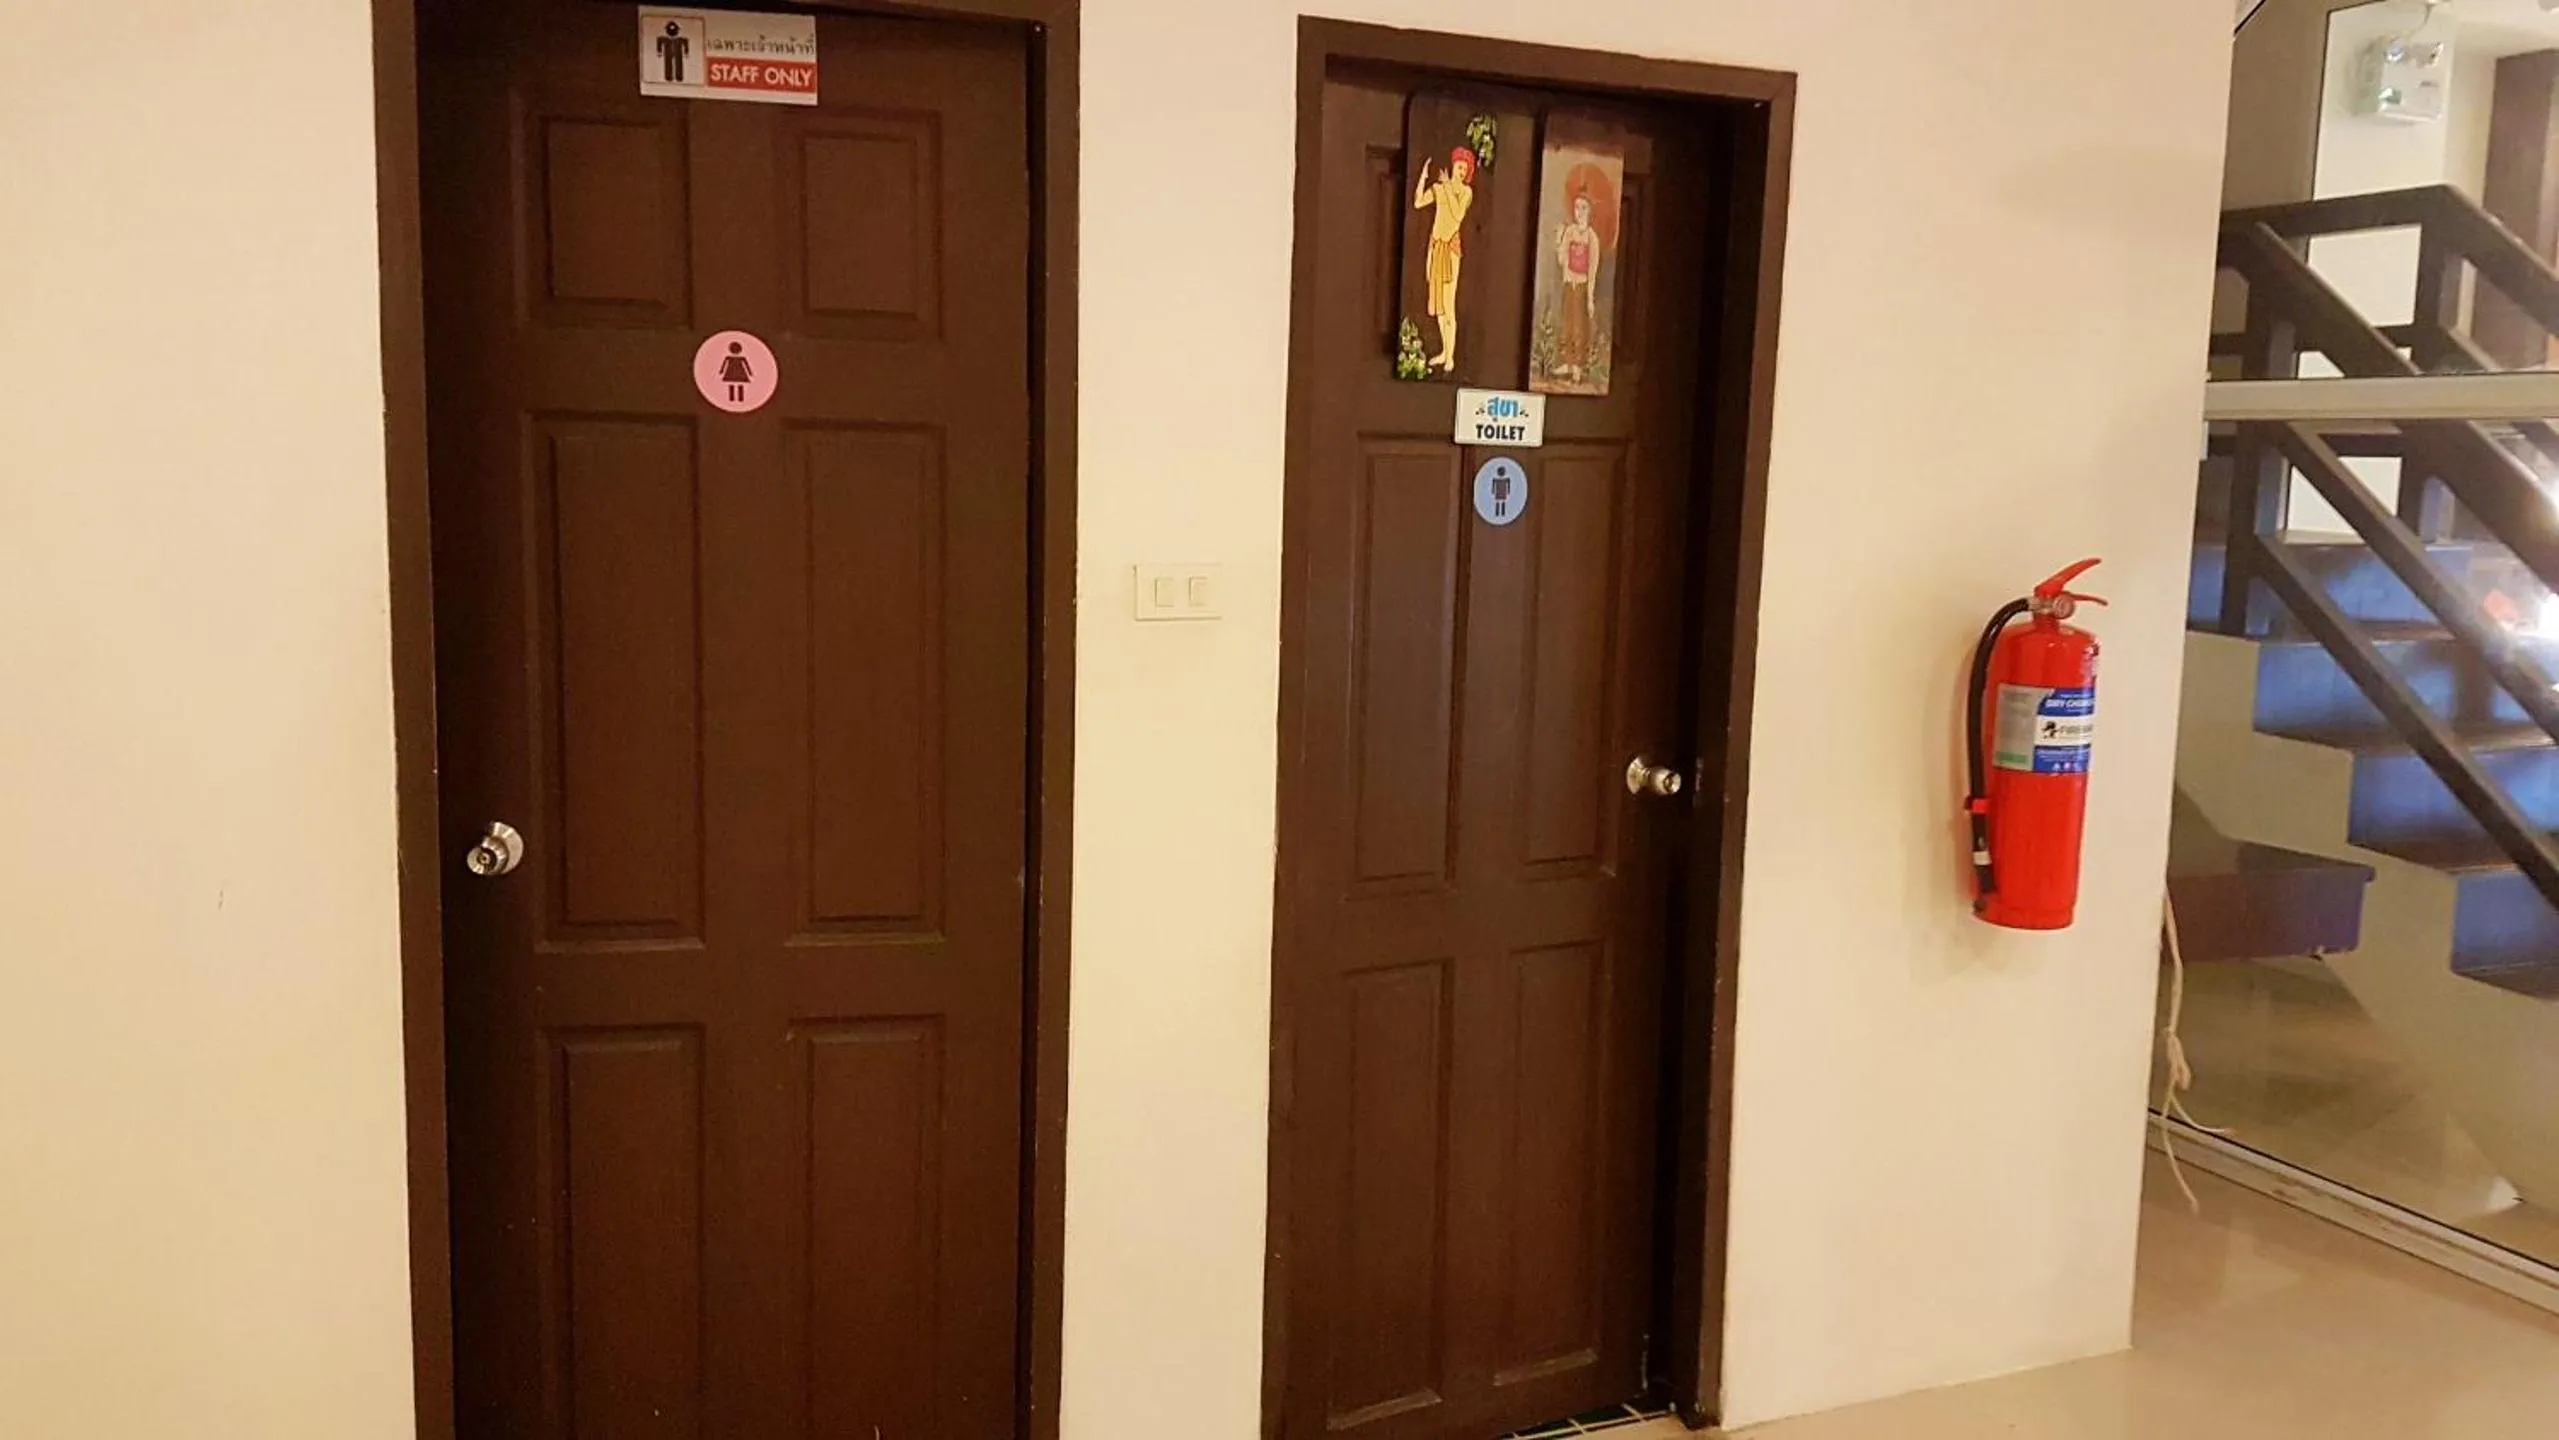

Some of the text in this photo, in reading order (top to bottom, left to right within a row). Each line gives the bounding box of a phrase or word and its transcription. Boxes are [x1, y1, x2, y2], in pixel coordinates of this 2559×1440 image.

[710, 63, 813, 87] STAFF ONLY
[1487, 396, 1519, 422] สุขา
[1475, 424, 1526, 441] TOILET
